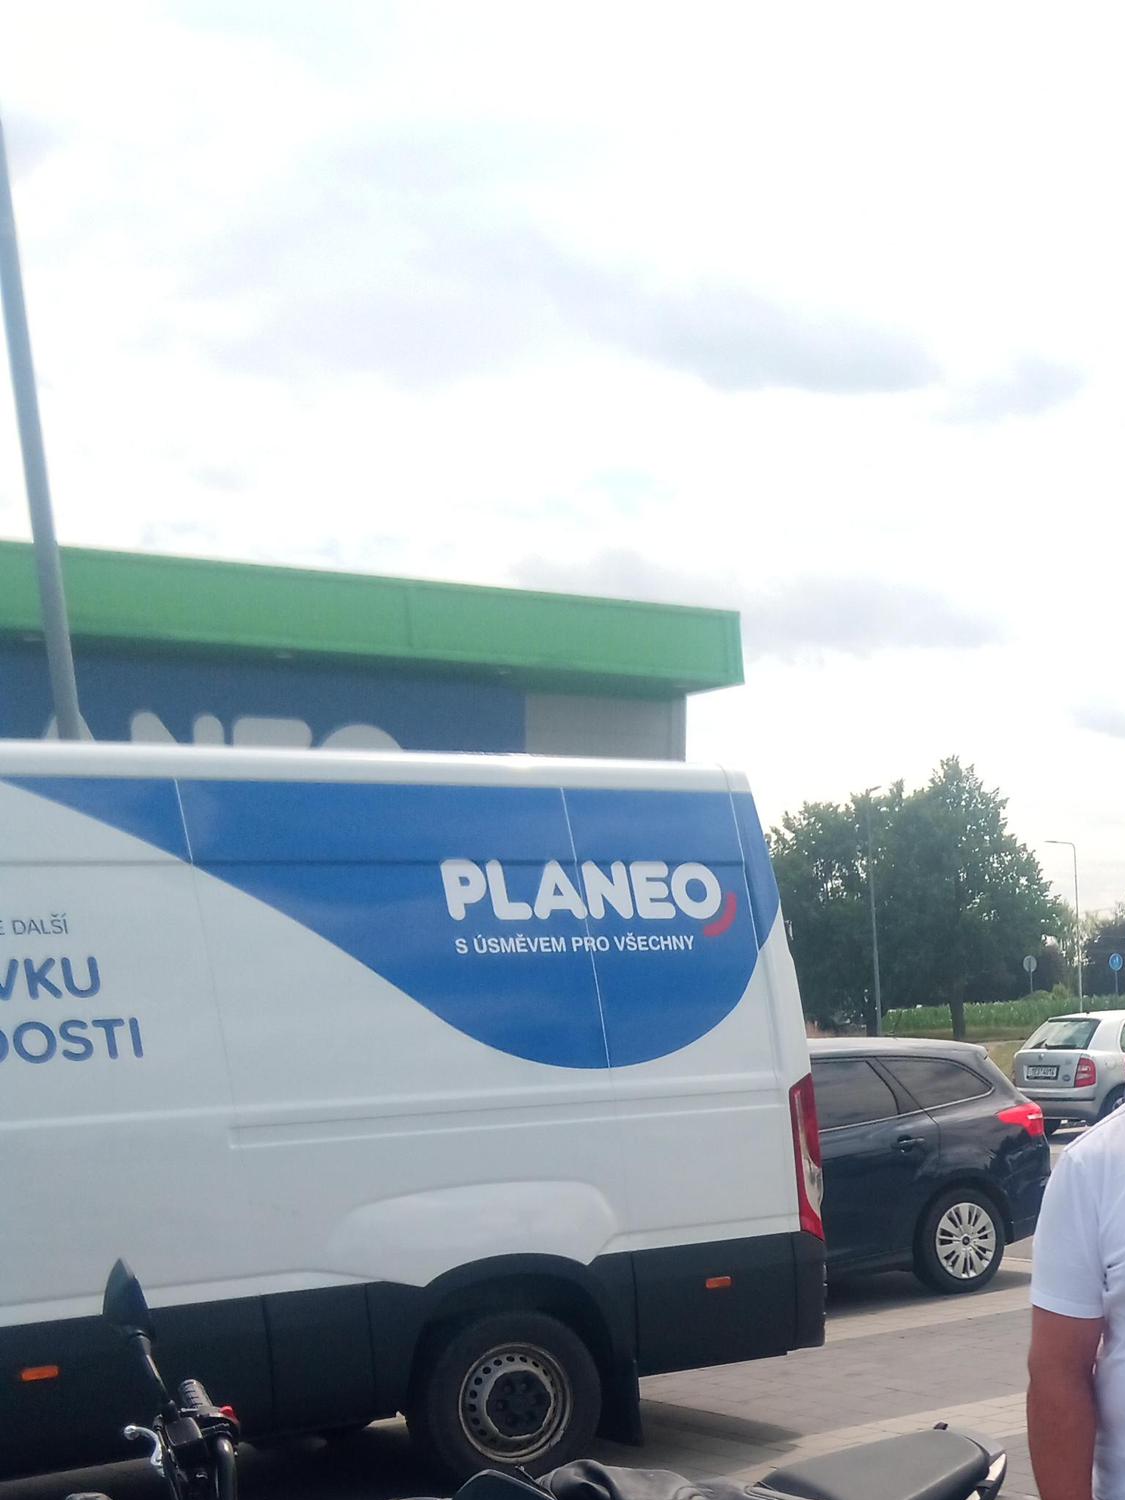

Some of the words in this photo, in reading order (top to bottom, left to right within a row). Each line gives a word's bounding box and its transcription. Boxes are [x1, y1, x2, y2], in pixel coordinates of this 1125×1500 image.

[440, 859, 721, 920] PLANEO
[12, 913, 68, 935] DALŠÍ
[455, 938, 468, 954] S
[474, 934, 565, 953] ÚSMĚVEM
[574, 936, 609, 952] PRO
[614, 932, 694, 951] VŠECHNY
[0, 1018, 144, 1064] OSTI
